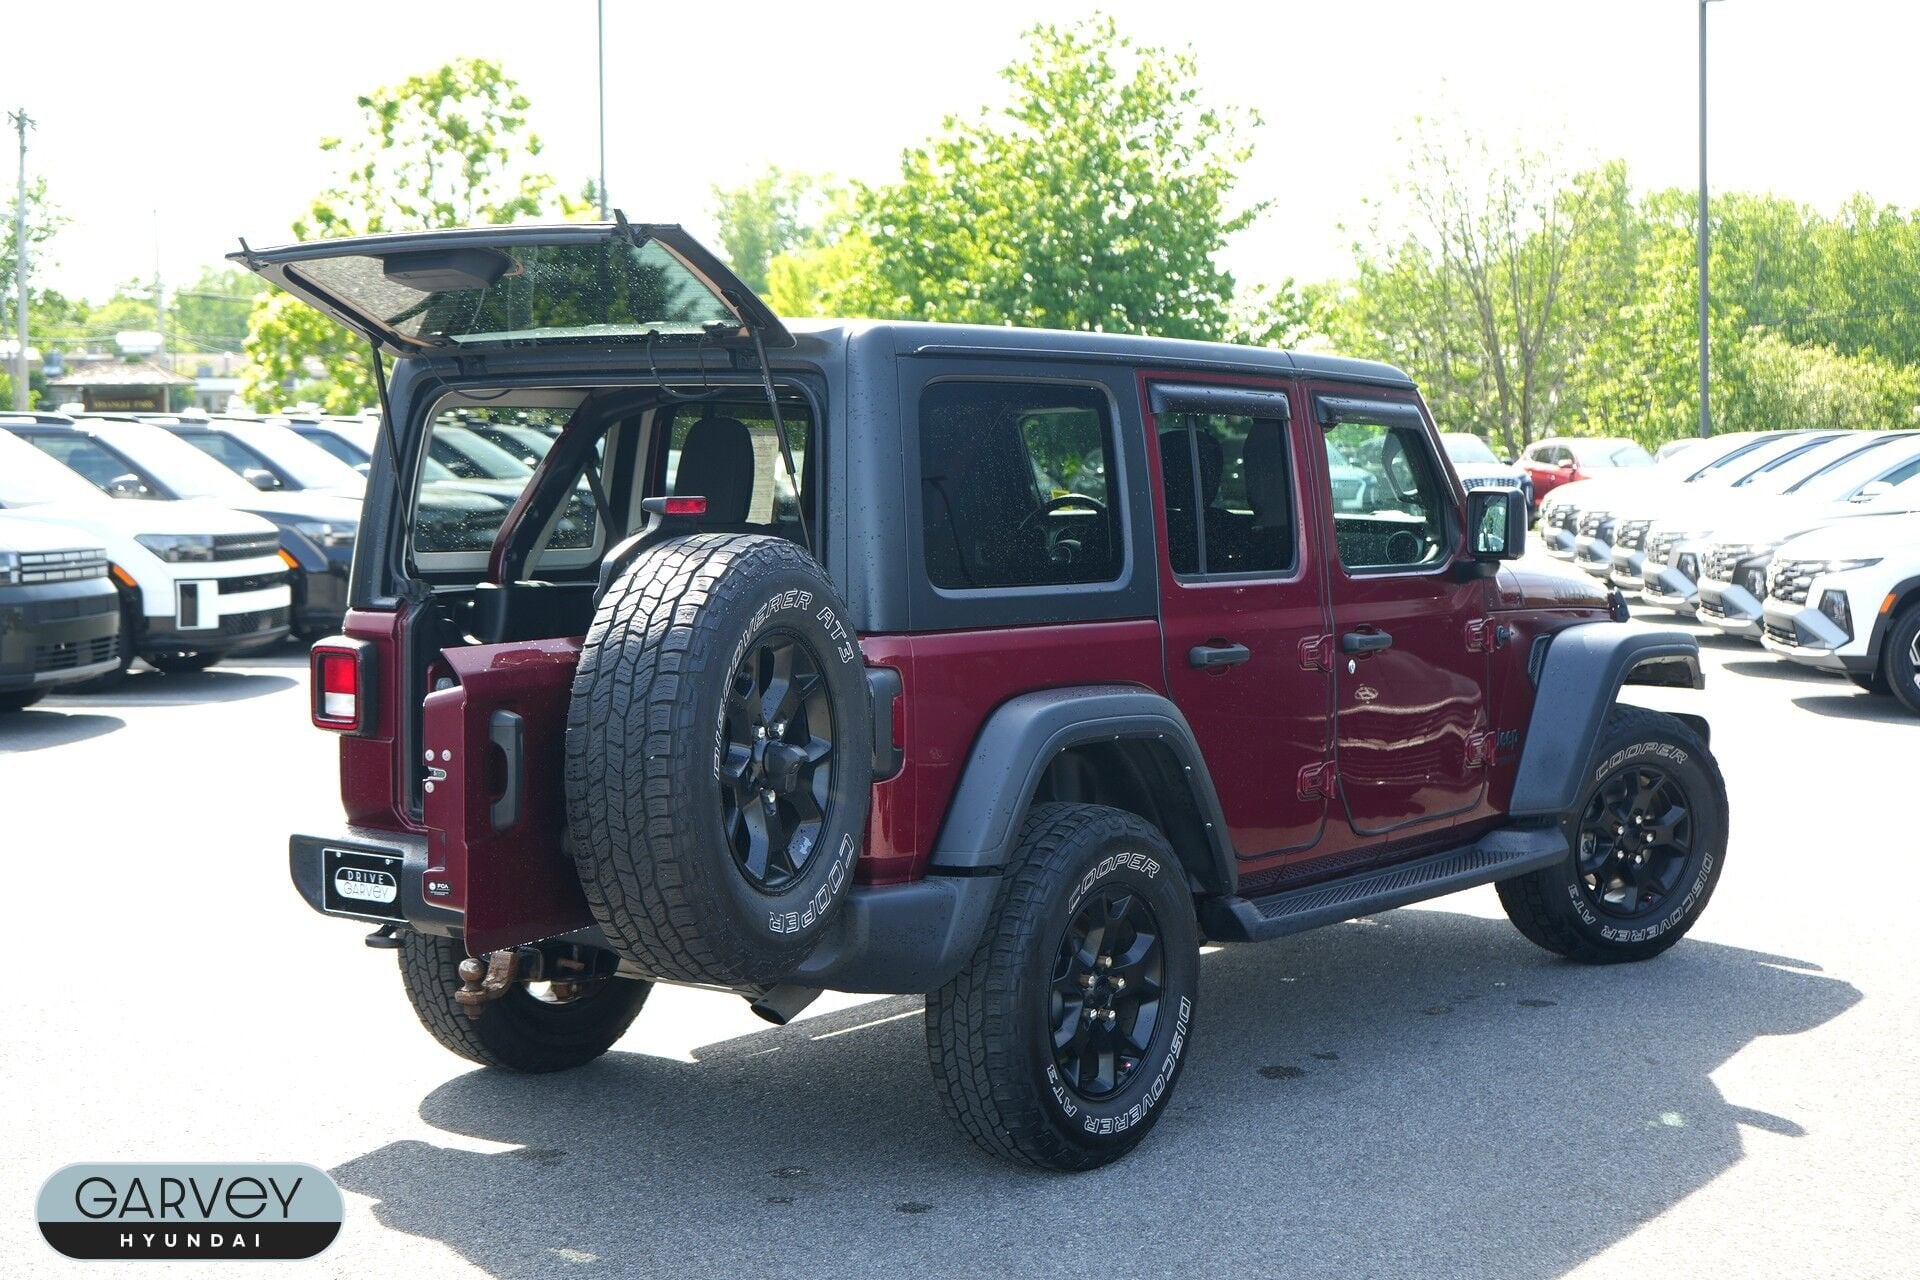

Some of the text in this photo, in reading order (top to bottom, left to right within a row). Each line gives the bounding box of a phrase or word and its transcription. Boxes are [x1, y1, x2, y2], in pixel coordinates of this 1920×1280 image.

[816, 606, 855, 664] AT3
[1595, 742, 1689, 782] COOPER
[347, 870, 384, 885] DRIVE
[769, 833, 855, 934] COOPER
[1068, 852, 1161, 914] COOPER
[1568, 853, 1713, 942] DISCOVERER AT3
[1047, 996, 1192, 1134] DISCOVERER AT3
